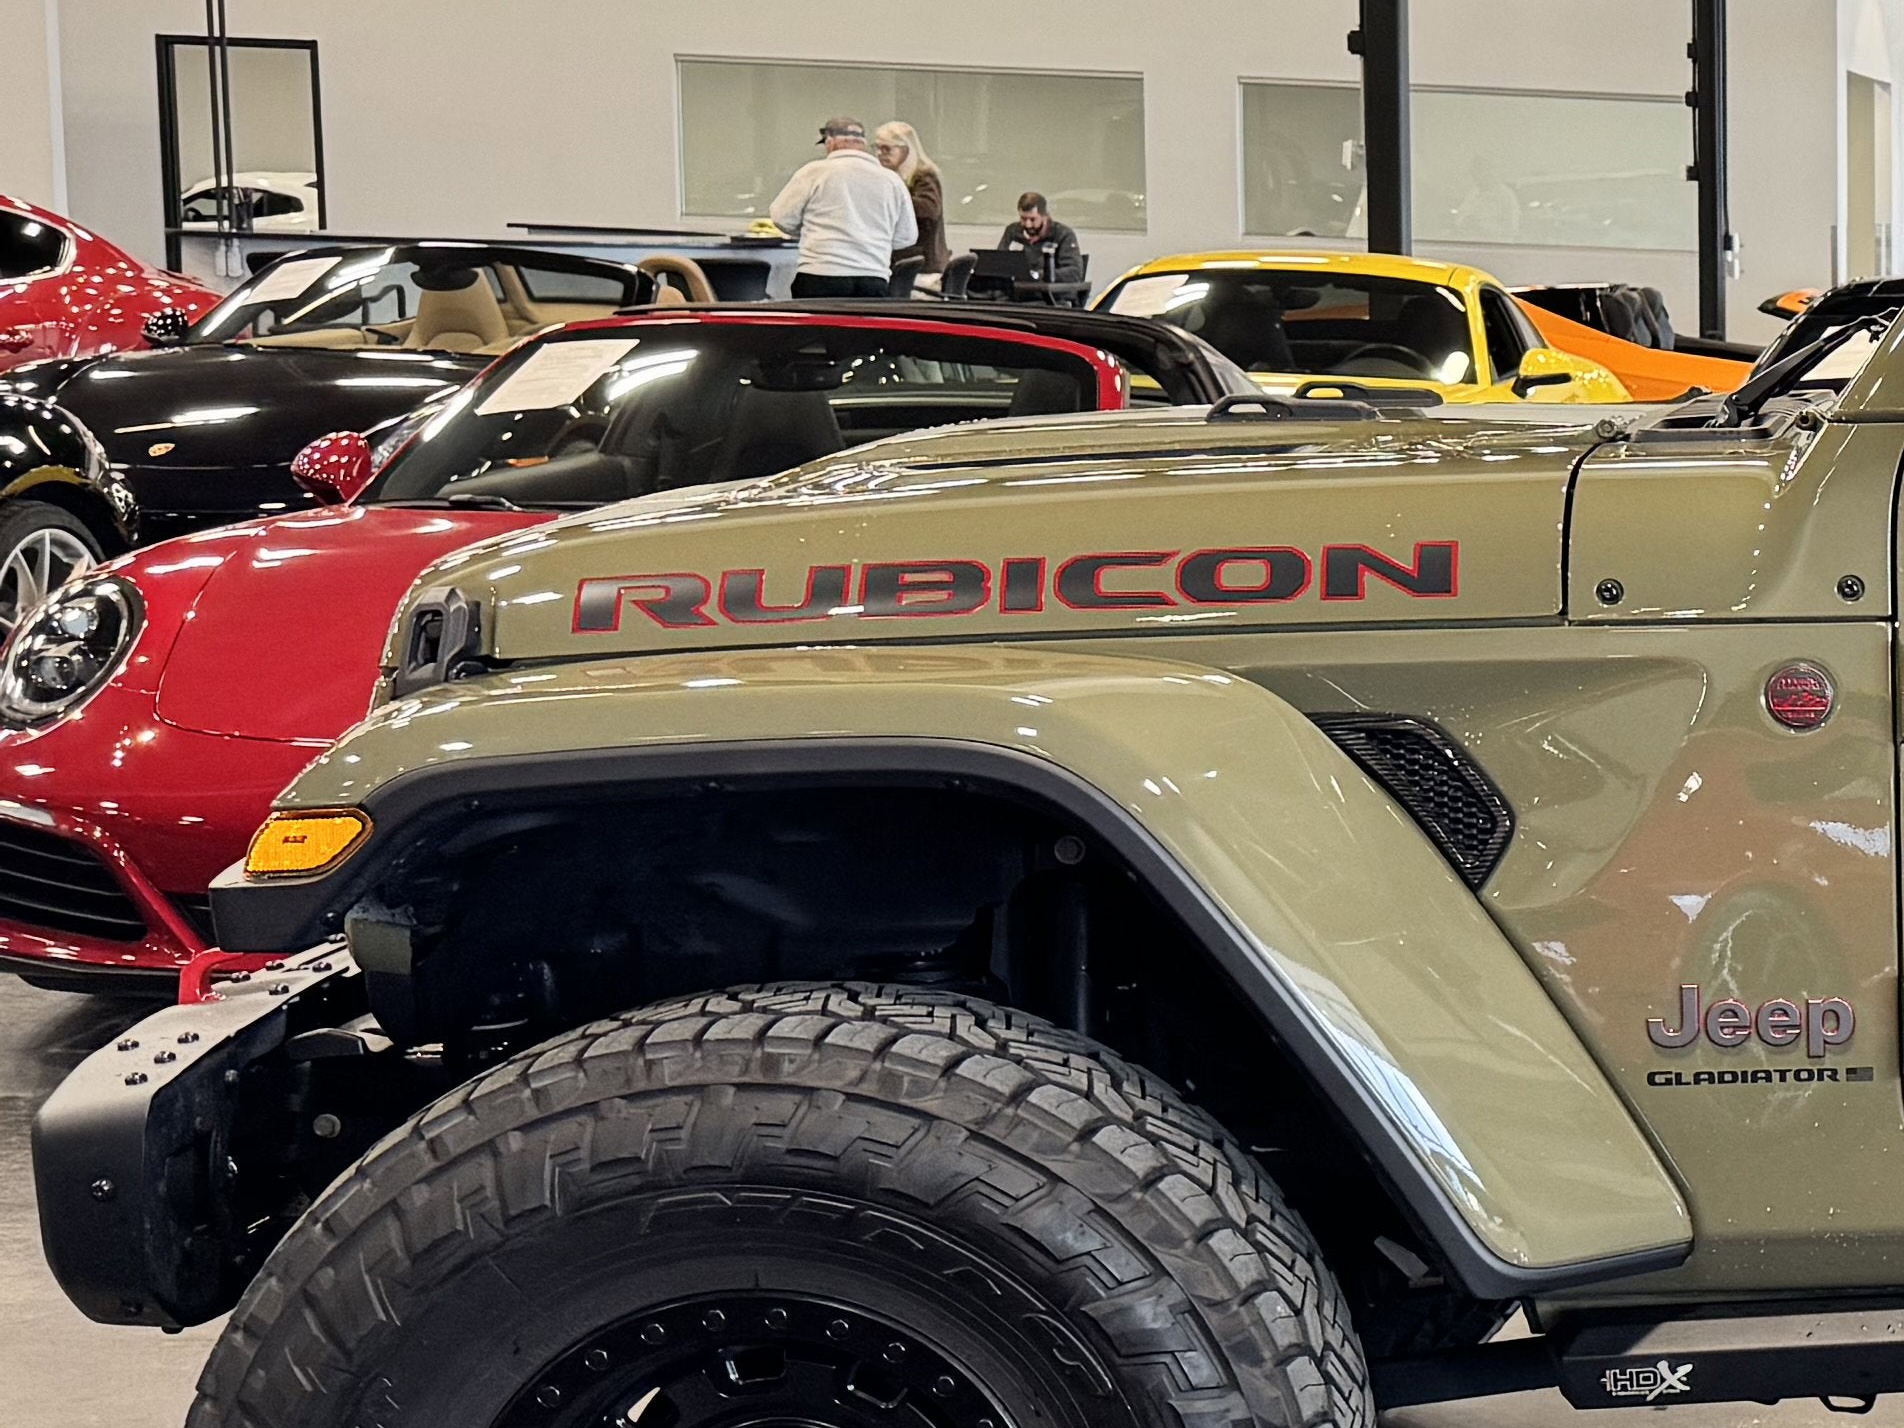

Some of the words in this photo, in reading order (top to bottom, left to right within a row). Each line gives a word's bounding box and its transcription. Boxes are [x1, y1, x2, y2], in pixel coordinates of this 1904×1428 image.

[571, 540, 1460, 634] RUBICON
[1647, 983, 1856, 1058] Jeep
[1646, 1068, 1840, 1087] GLADIATOR
[1608, 1359, 1694, 1402] HDX
